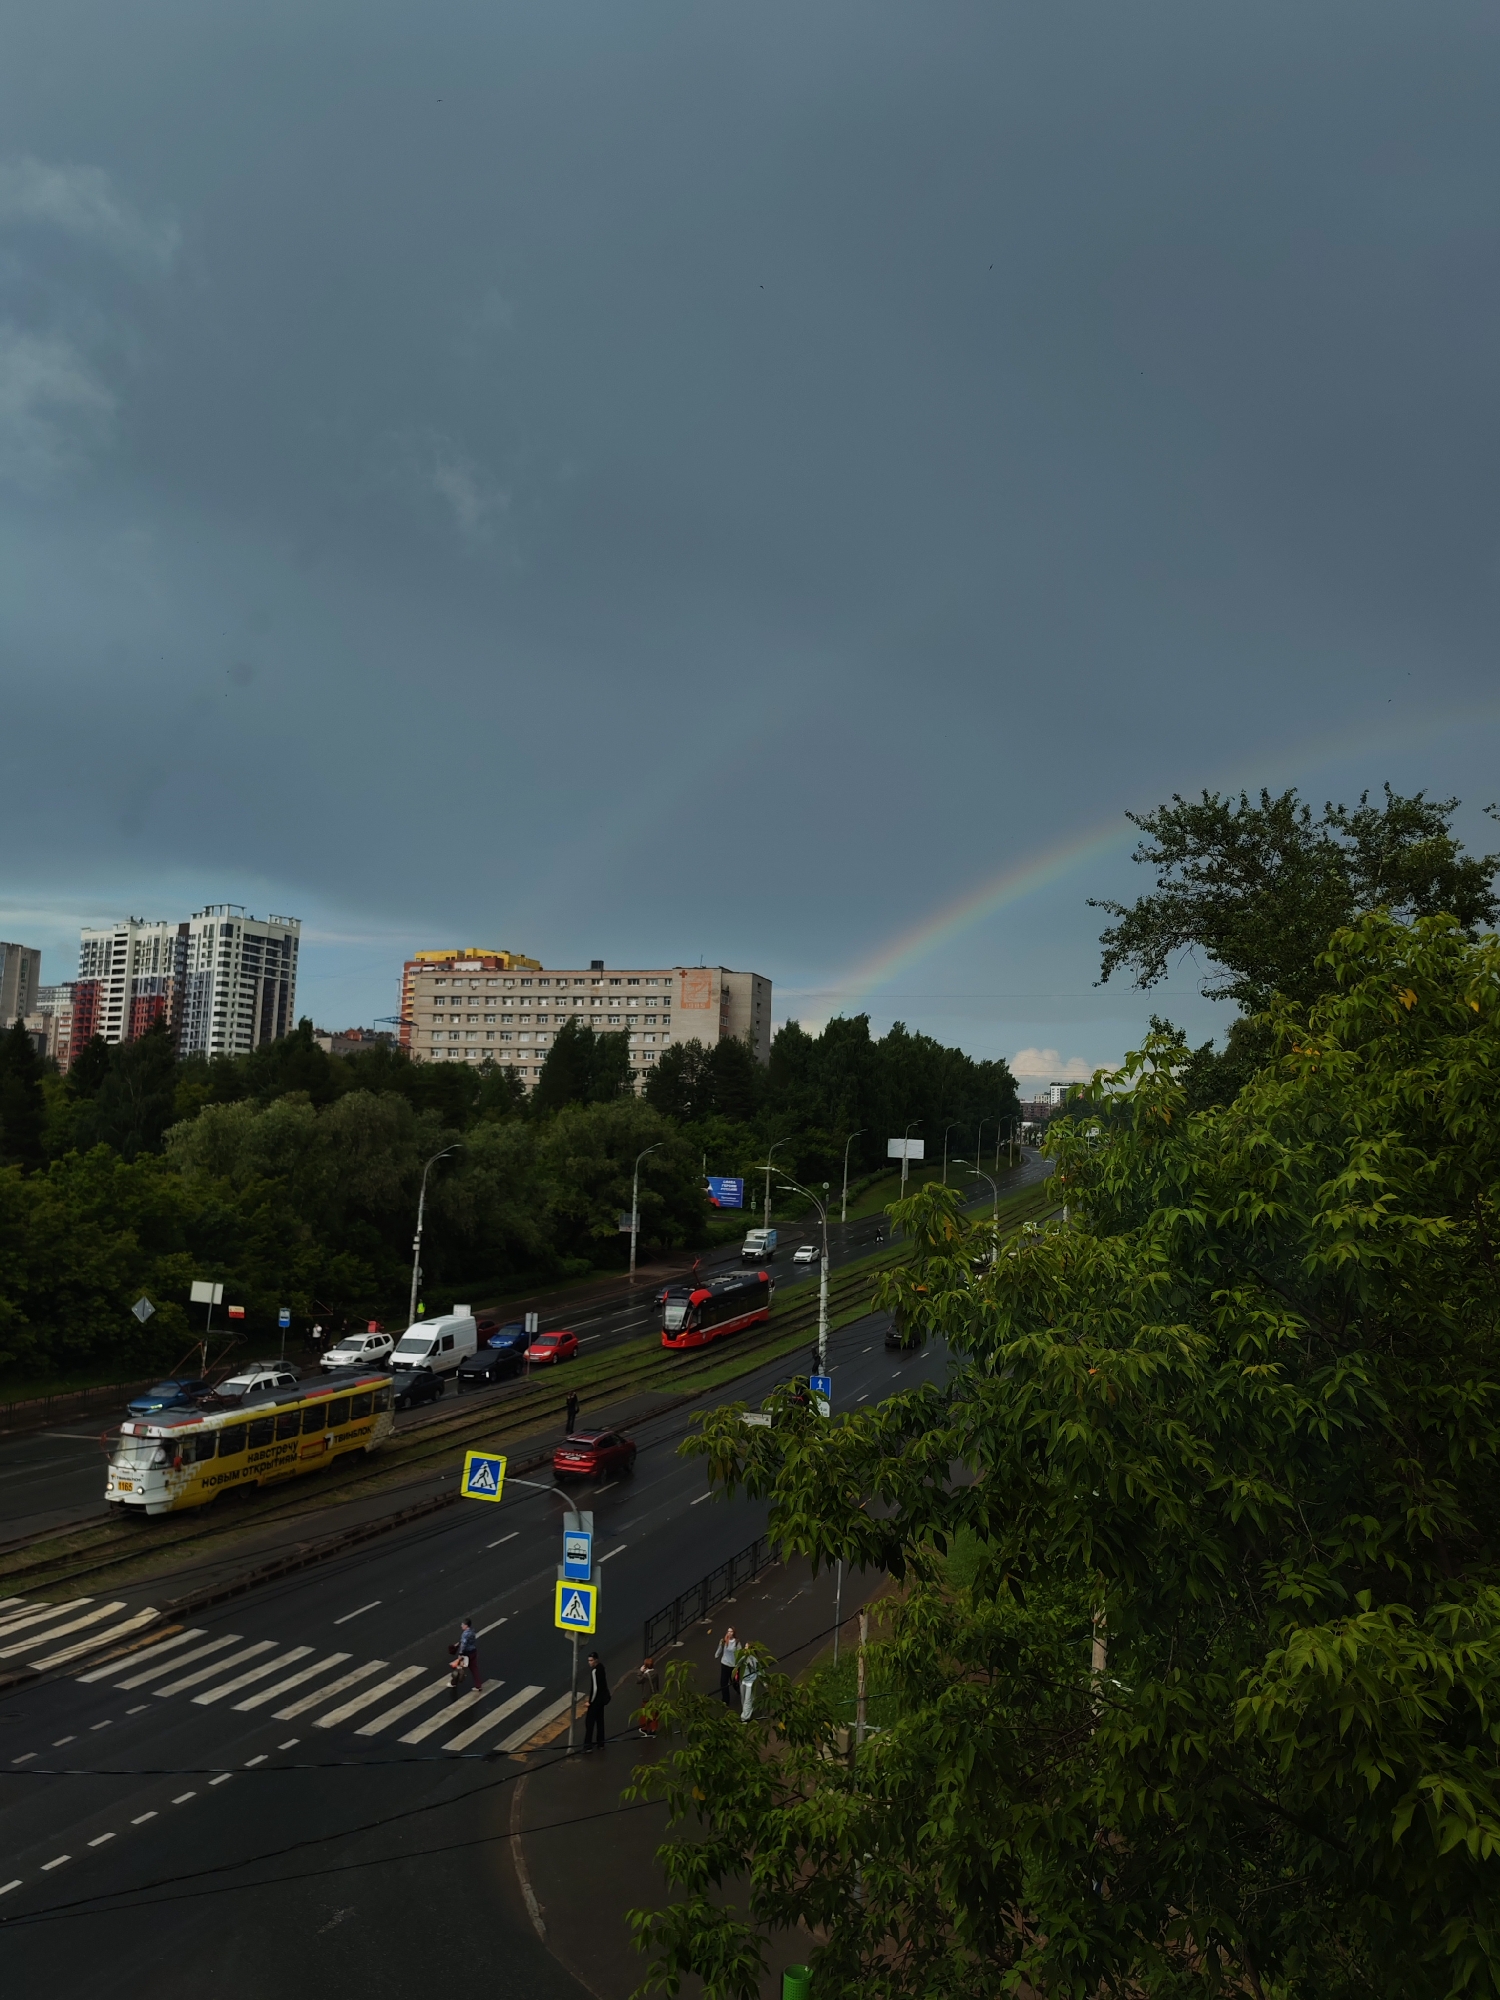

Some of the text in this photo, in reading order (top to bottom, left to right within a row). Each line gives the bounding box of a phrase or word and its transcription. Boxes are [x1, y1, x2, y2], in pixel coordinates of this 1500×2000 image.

[334, 1426, 372, 1443] ТВИНБЛОК
[248, 1440, 299, 1463] навстречу
[202, 1471, 240, 1488] новым
[242, 1453, 298, 1475] открытиям
[118, 1483, 133, 1491] 1165
